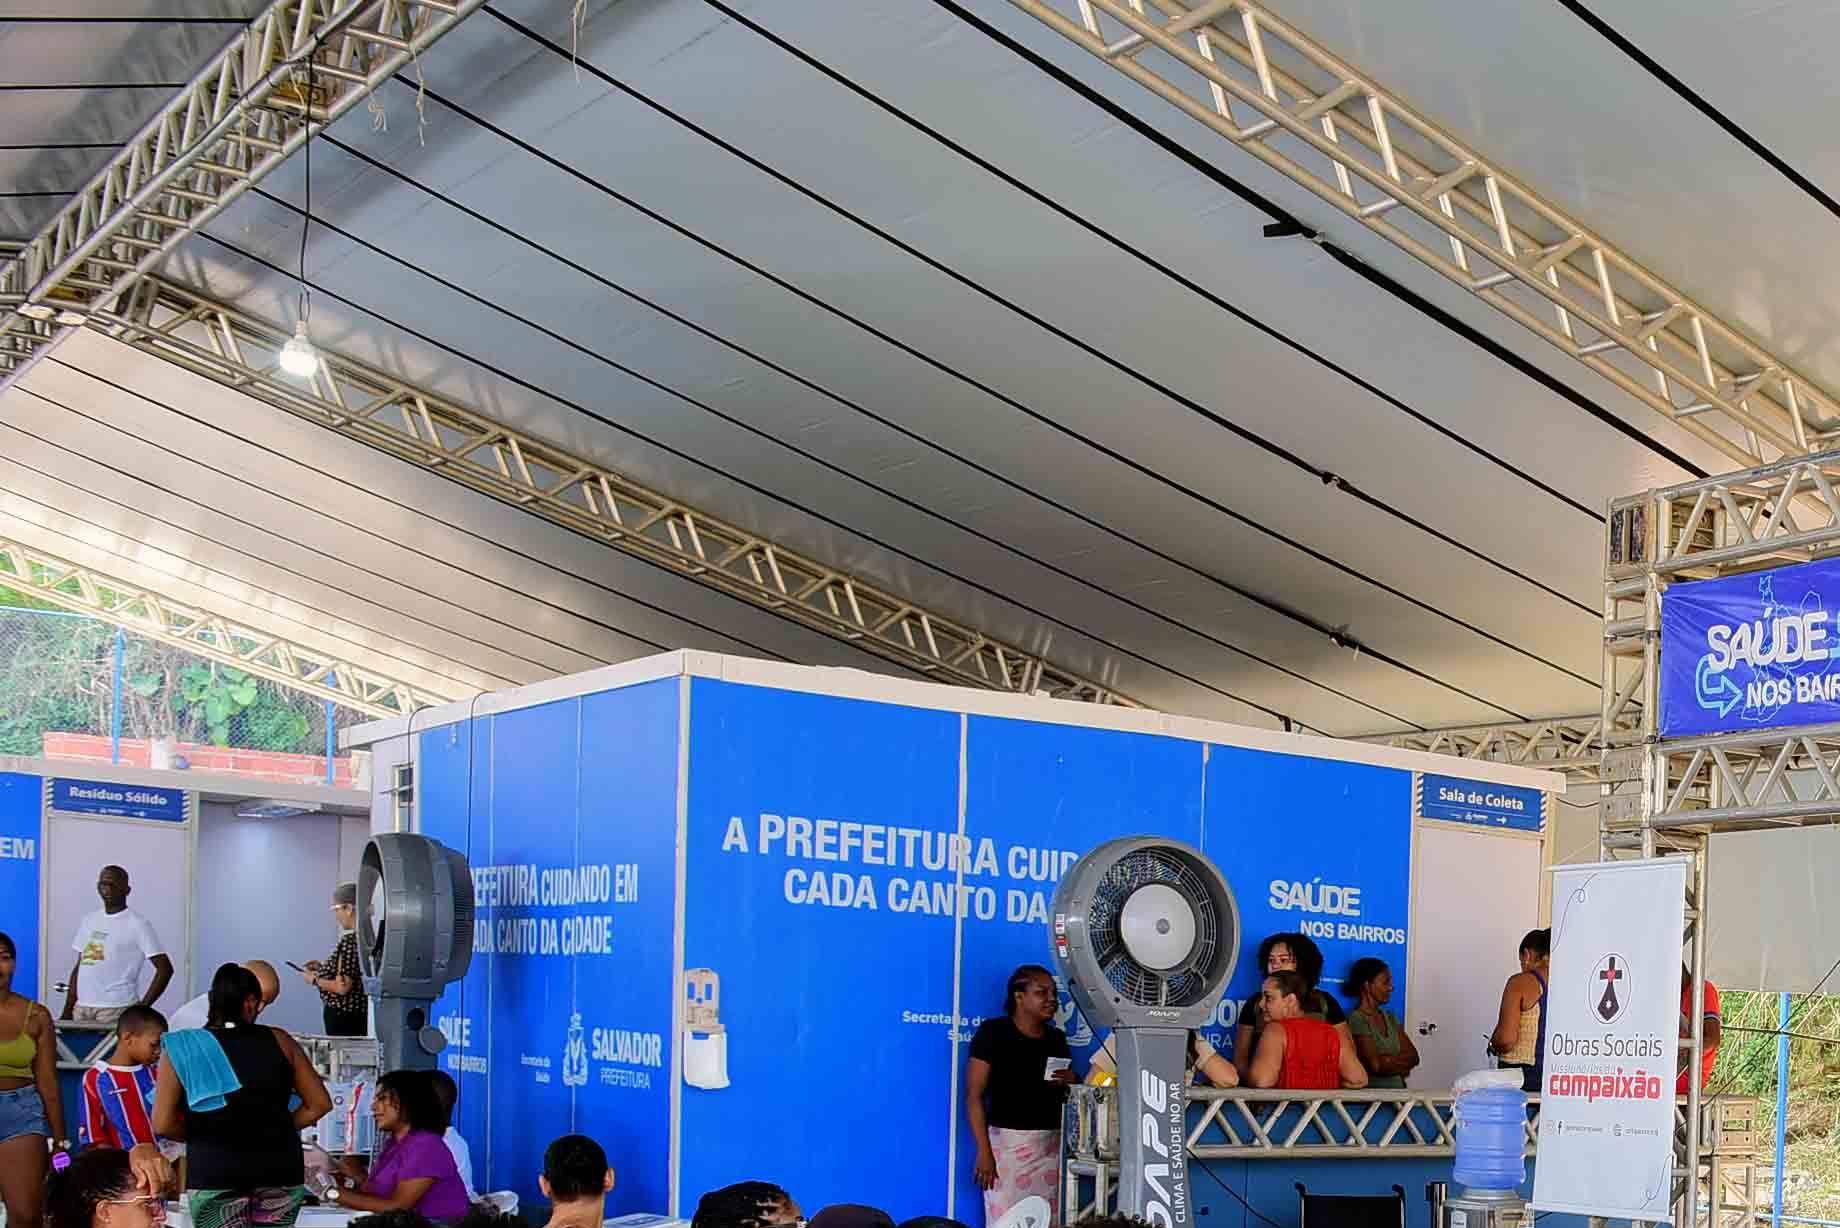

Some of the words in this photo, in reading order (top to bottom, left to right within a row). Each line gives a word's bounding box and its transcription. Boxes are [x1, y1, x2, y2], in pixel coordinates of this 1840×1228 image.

[1707, 607, 1829, 670] SAÚDE
[1746, 678, 1792, 708] NOS
[69, 786, 123, 801] Resíduo
[126, 790, 168, 806] Sólido
[1439, 787, 1465, 803] Sala
[1467, 790, 1483, 806] de
[1485, 794, 1524, 811] Coleta
[722, 816, 749, 853] A
[759, 813, 1000, 877] PREFEITURA
[541, 864, 611, 906] CUIDANDO
[615, 863, 639, 903] EM
[784, 868, 878, 910] CADA
[887, 877, 997, 922] CANTO
[1007, 889, 1049, 924] DA
[1269, 877, 1361, 917] SAÚDE
[497, 918, 539, 955] CANTO
[540, 917, 560, 955] DA
[562, 915, 613, 956] CIDADE
[1300, 919, 1334, 939] NOS
[1338, 923, 1406, 945] BAIRROS
[591, 1028, 662, 1067] SALVADOR
[1552, 1032, 1600, 1057] Obras
[1603, 1032, 1663, 1057] Sociais
[600, 1067, 650, 1088] PREFEITURA
[1169, 1082, 1181, 1100] AR
[1549, 1067, 1662, 1103] compaixão
[1170, 1103, 1182, 1124] NO
[1169, 1127, 1183, 1169] SAÚDE
[1173, 1170, 1184, 1180] E
[1171, 1182, 1186, 1223] CLIMA
